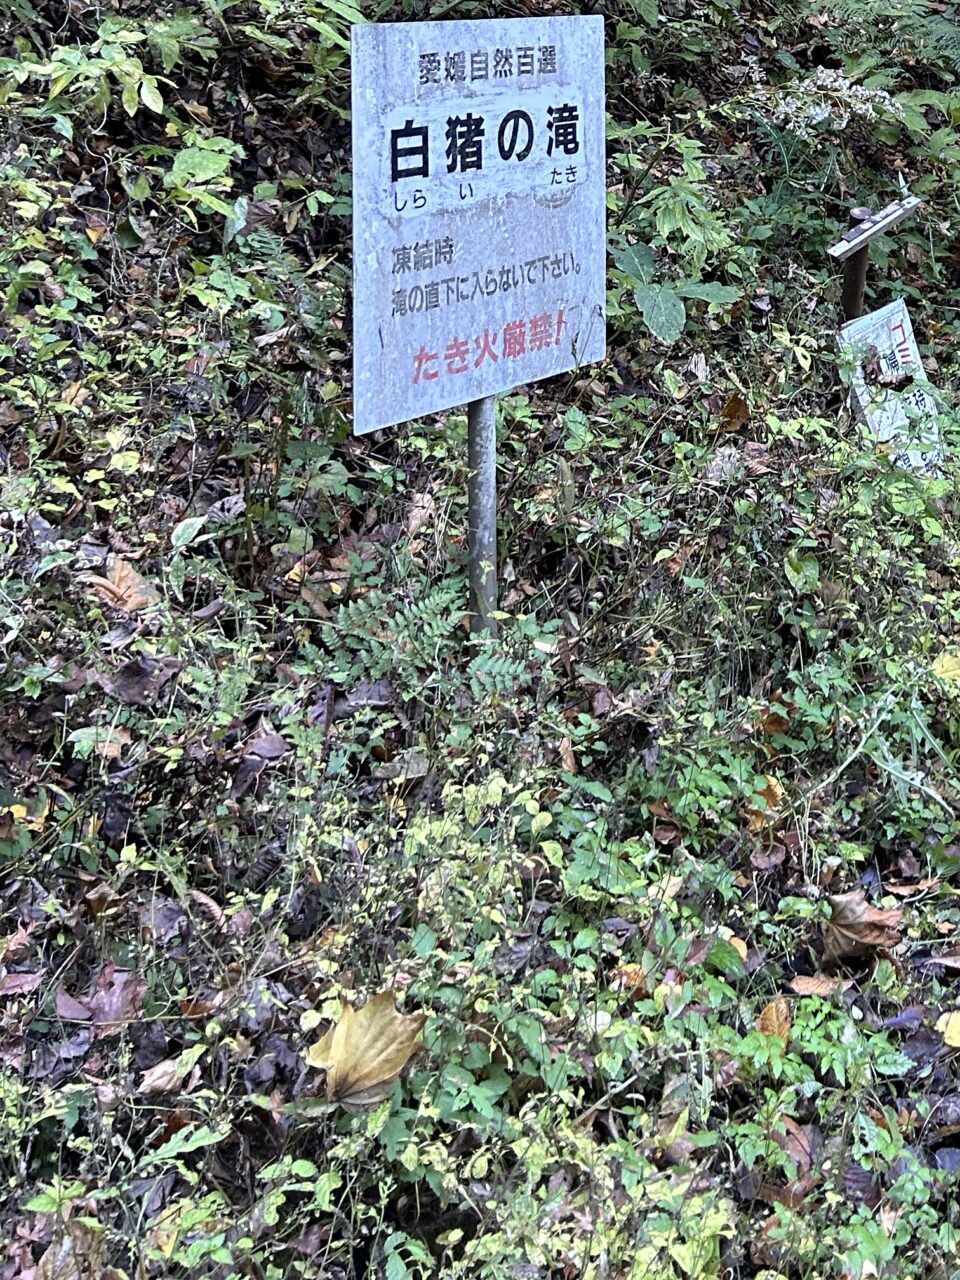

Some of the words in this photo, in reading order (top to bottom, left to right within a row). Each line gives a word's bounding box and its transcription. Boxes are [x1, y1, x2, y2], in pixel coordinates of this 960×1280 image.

[418, 45, 557, 85] 愛媛自然百選
[391, 103, 579, 182] 白猪の滝
[394, 189, 427, 211] しら
[459, 183, 473, 200] い
[550, 165, 577, 185] たき
[391, 236, 454, 274] 凍結時
[391, 252, 581, 317] 滝の直下に入らないで下さい。
[412, 309, 565, 385] たき火厳禁!
